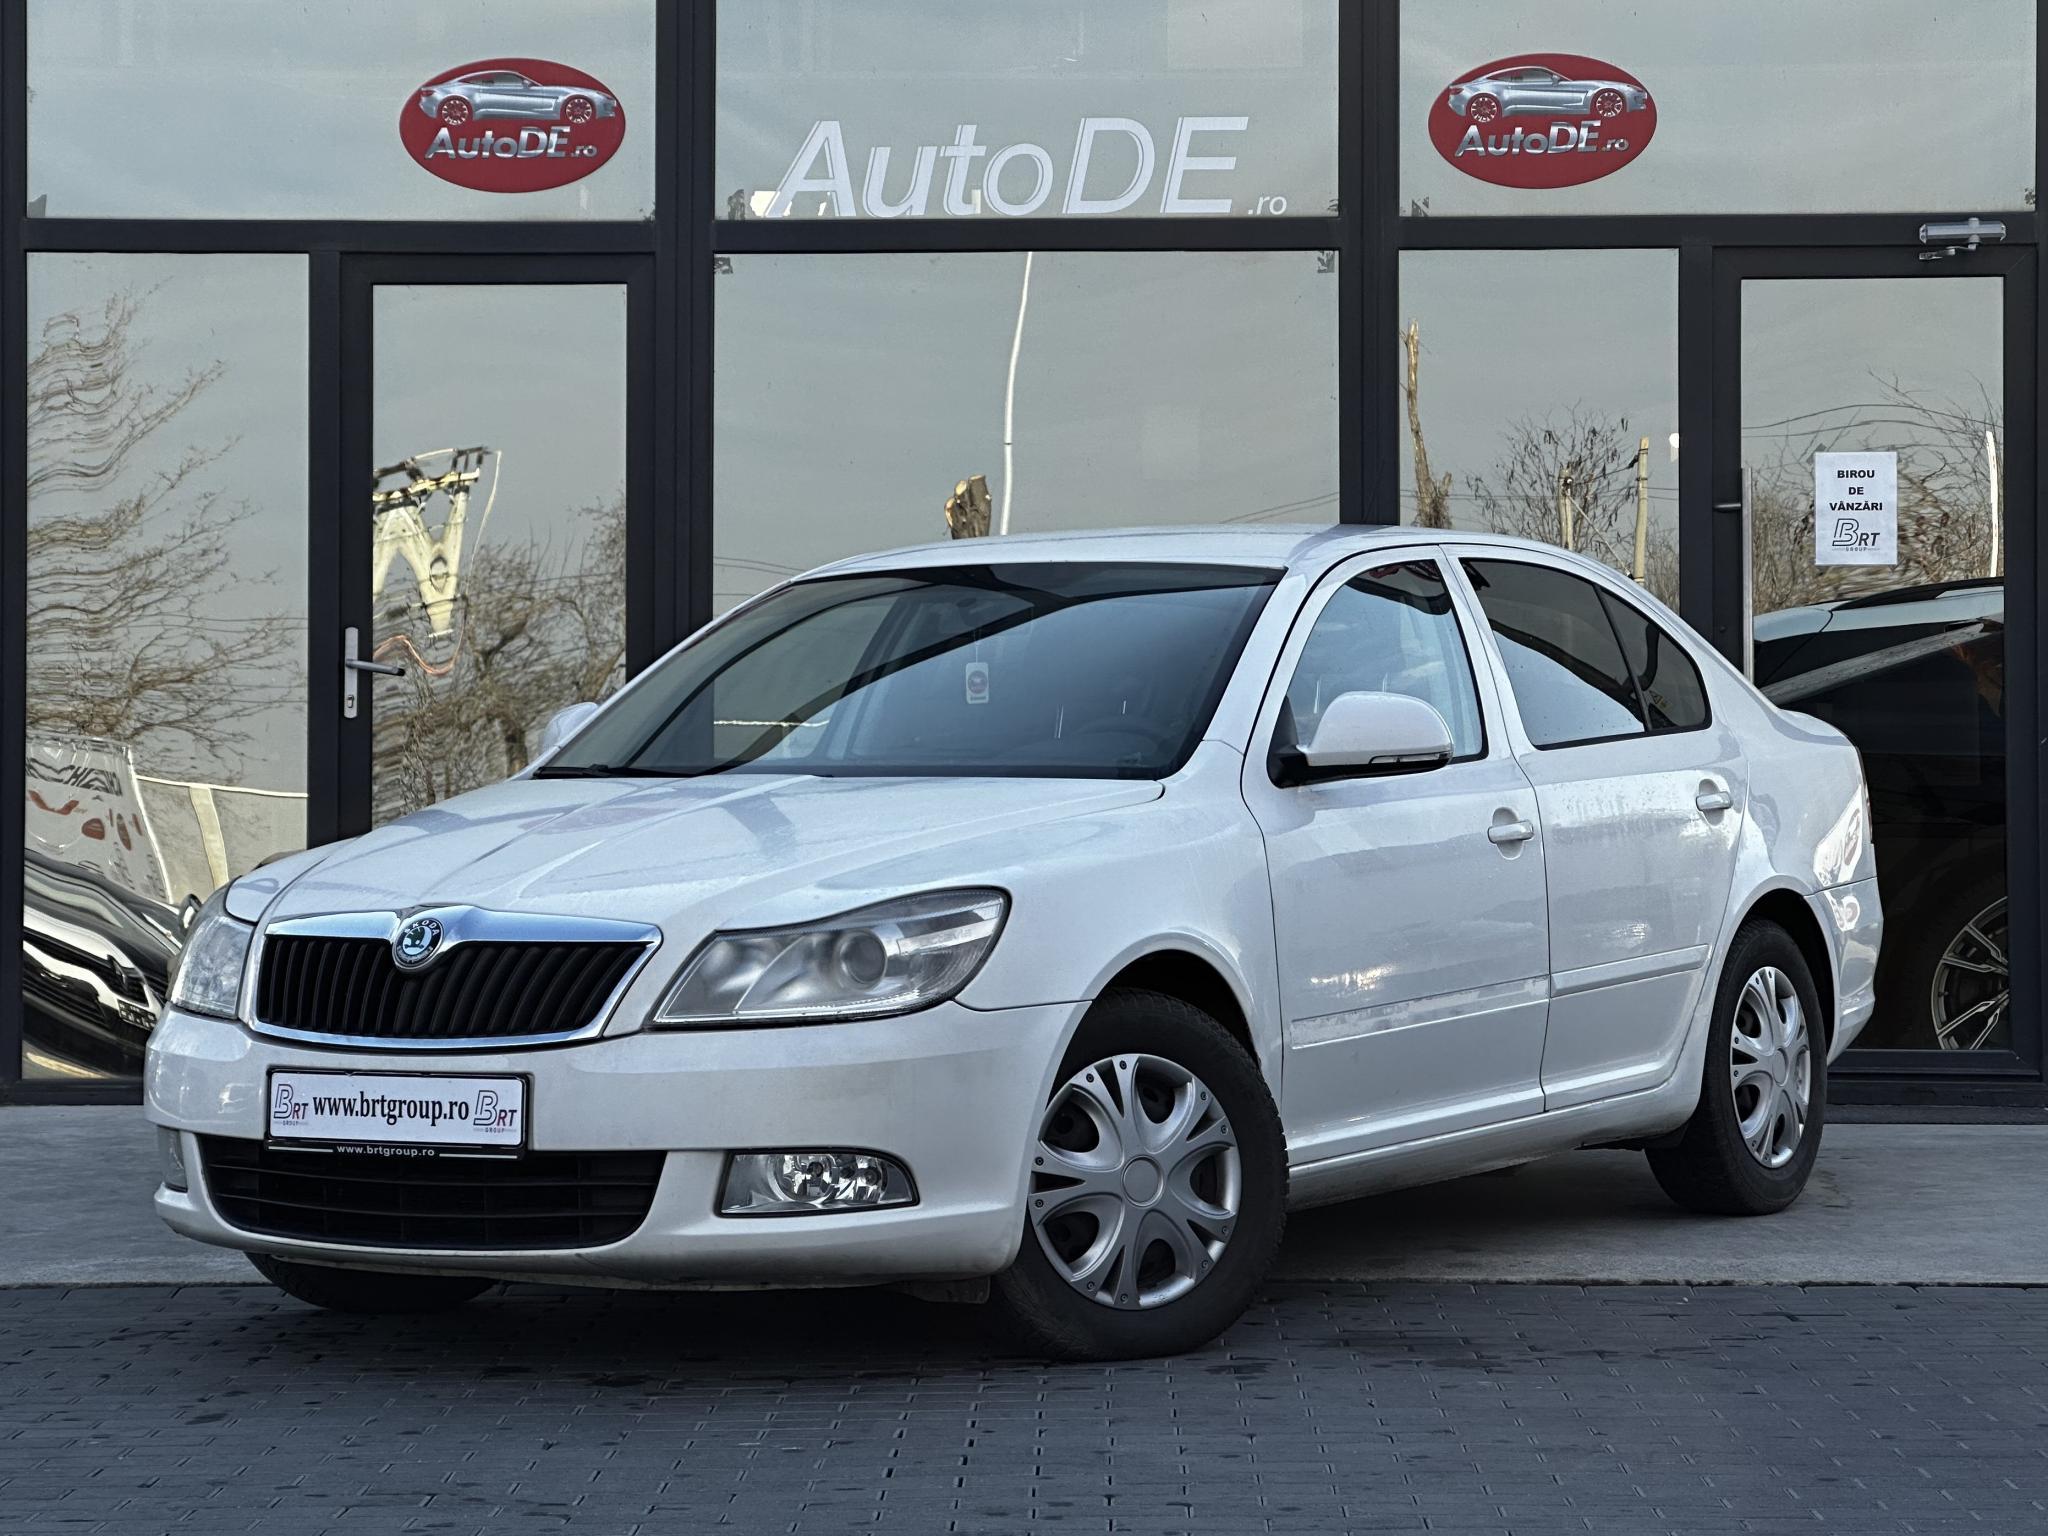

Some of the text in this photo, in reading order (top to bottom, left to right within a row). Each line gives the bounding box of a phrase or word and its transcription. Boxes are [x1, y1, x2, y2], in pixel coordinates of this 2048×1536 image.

[1837, 470, 1875, 479] BIROU
[1848, 487, 1865, 495] DE
[1829, 501, 1883, 511] VÂNZĂRI
[1832, 518, 1881, 546] BRT
[273, 1084, 518, 1127] BRT www.brtgroup.ro BRT
[336, 1145, 436, 1157] www.brtgroup.ro
